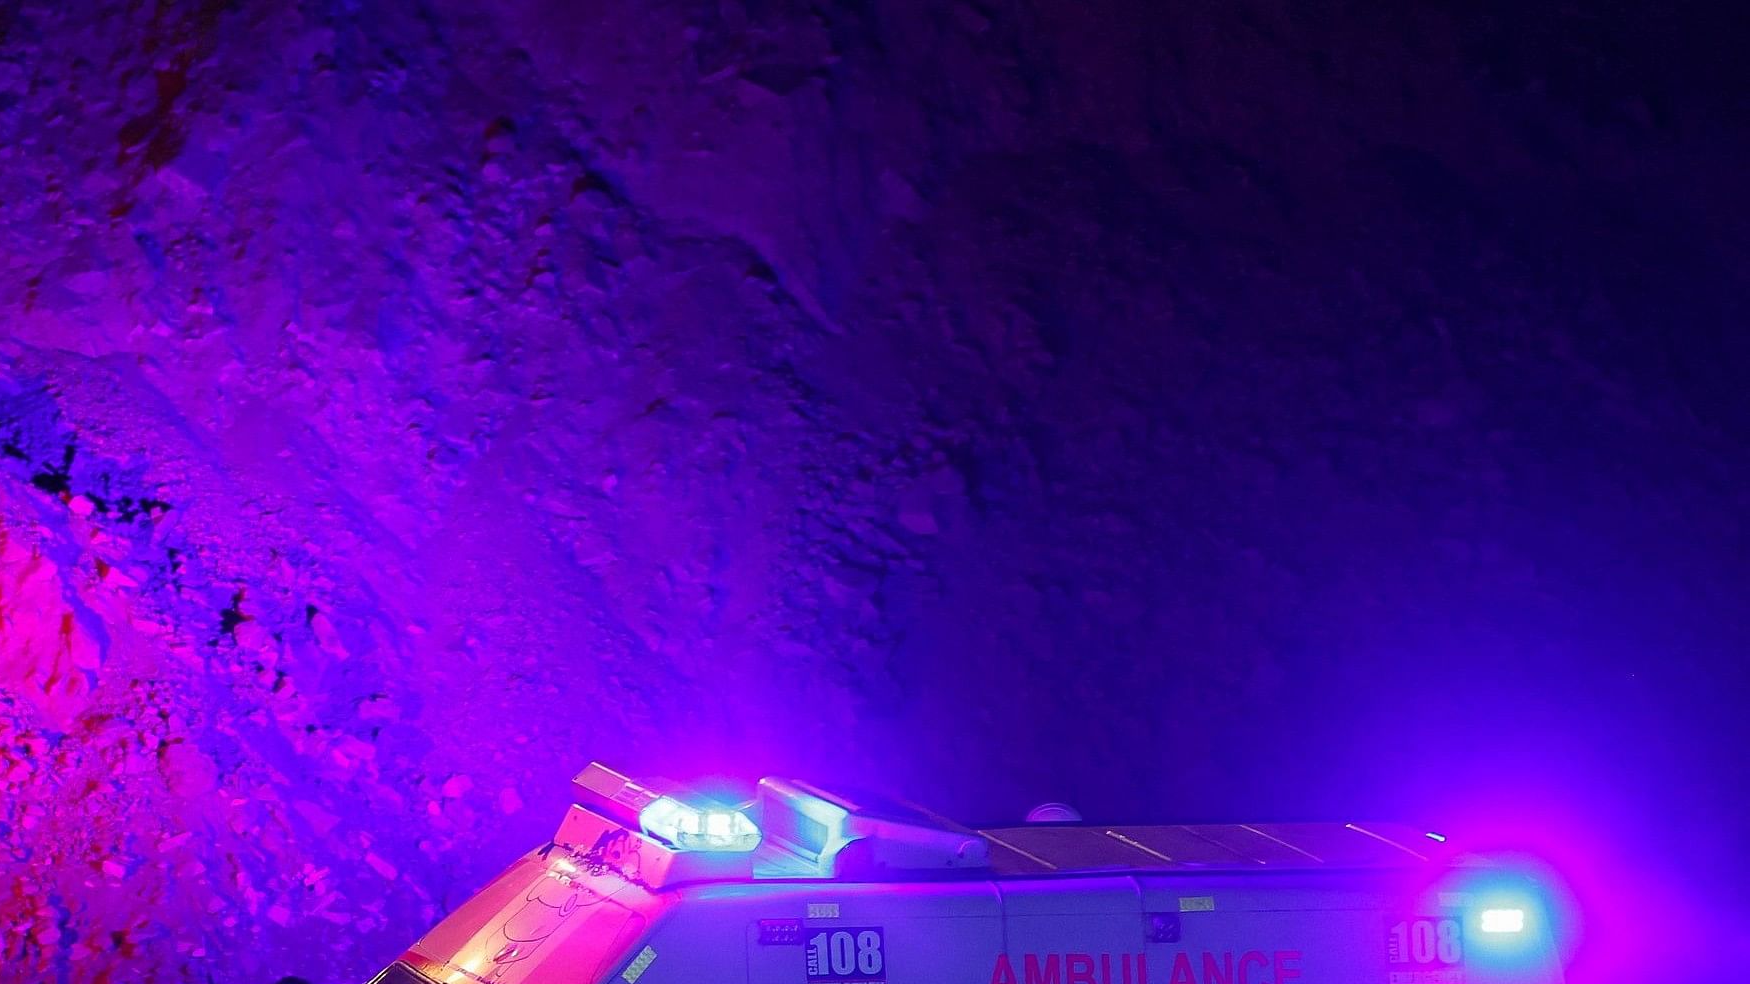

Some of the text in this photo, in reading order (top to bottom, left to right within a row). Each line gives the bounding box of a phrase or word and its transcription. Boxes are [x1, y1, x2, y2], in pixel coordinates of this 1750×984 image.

[806, 948, 818, 976] CALL
[809, 930, 883, 975] 108
[1390, 919, 1462, 964] 108
